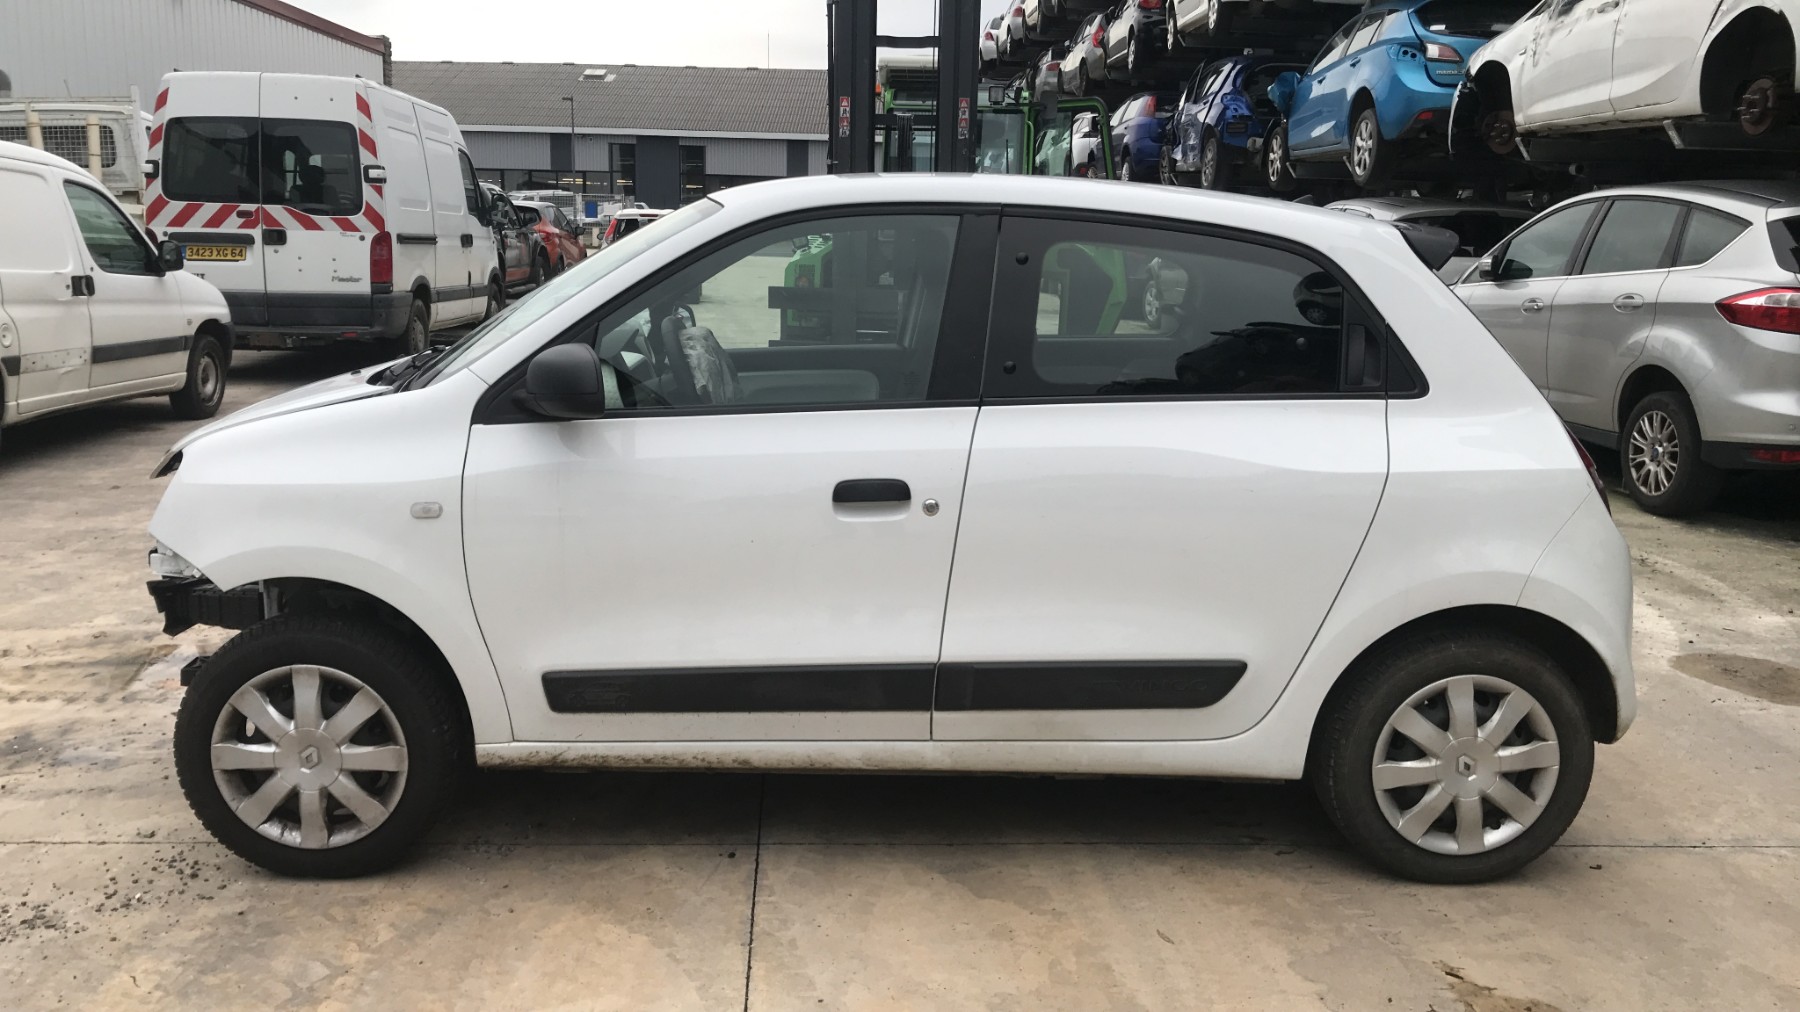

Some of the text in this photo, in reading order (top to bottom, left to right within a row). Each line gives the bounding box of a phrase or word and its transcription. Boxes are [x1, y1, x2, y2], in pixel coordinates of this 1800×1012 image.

[187, 247, 244, 258] 3423 XG 64
